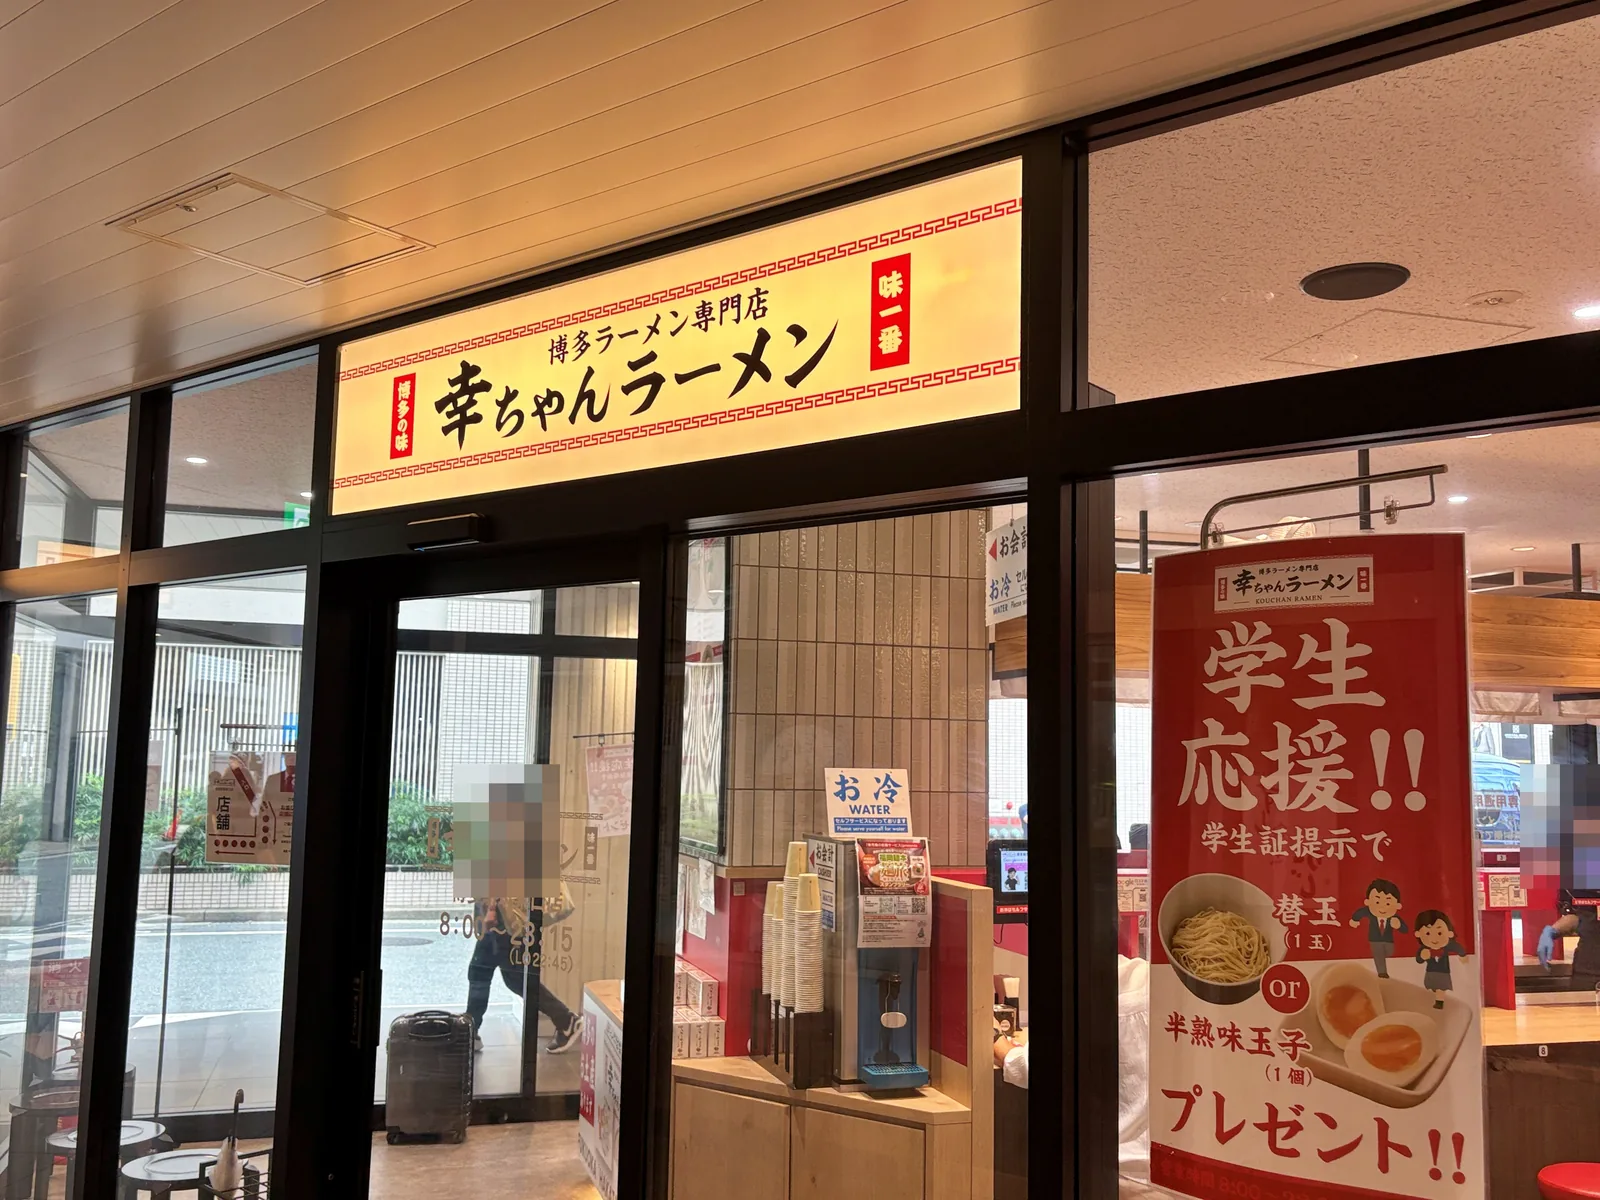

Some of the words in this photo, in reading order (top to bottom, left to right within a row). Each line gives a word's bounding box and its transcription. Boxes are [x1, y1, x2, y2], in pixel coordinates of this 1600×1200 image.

[548, 287, 770, 366] 博多ラーメン専門店
[877, 269, 904, 355] 味一番
[433, 319, 839, 451] 幸ちゃんラーメン
[394, 379, 412, 452] 博多の味
[989, 572, 1012, 602] お冷
[1232, 568, 1355, 597] 幸ちゃんラーメン
[1258, 563, 1320, 576] 博多ラーメン専門店
[1255, 596, 1292, 605] KOUCHAN
[1294, 594, 1323, 603] RAMEN
[1202, 618, 1386, 714] 学生
[1177, 717, 1427, 813] 応援!!
[833, 772, 903, 804] お冷
[216, 795, 231, 831] 店舗
[848, 804, 891, 815] WATER
[1200, 821, 1393, 863] 学生証提示で
[1273, 892, 1342, 927] 替玉
[1269, 978, 1302, 1000] or
[1164, 1010, 1311, 1062] 半熟味玉子
[1161, 1083, 1466, 1185] プレゼント!!
